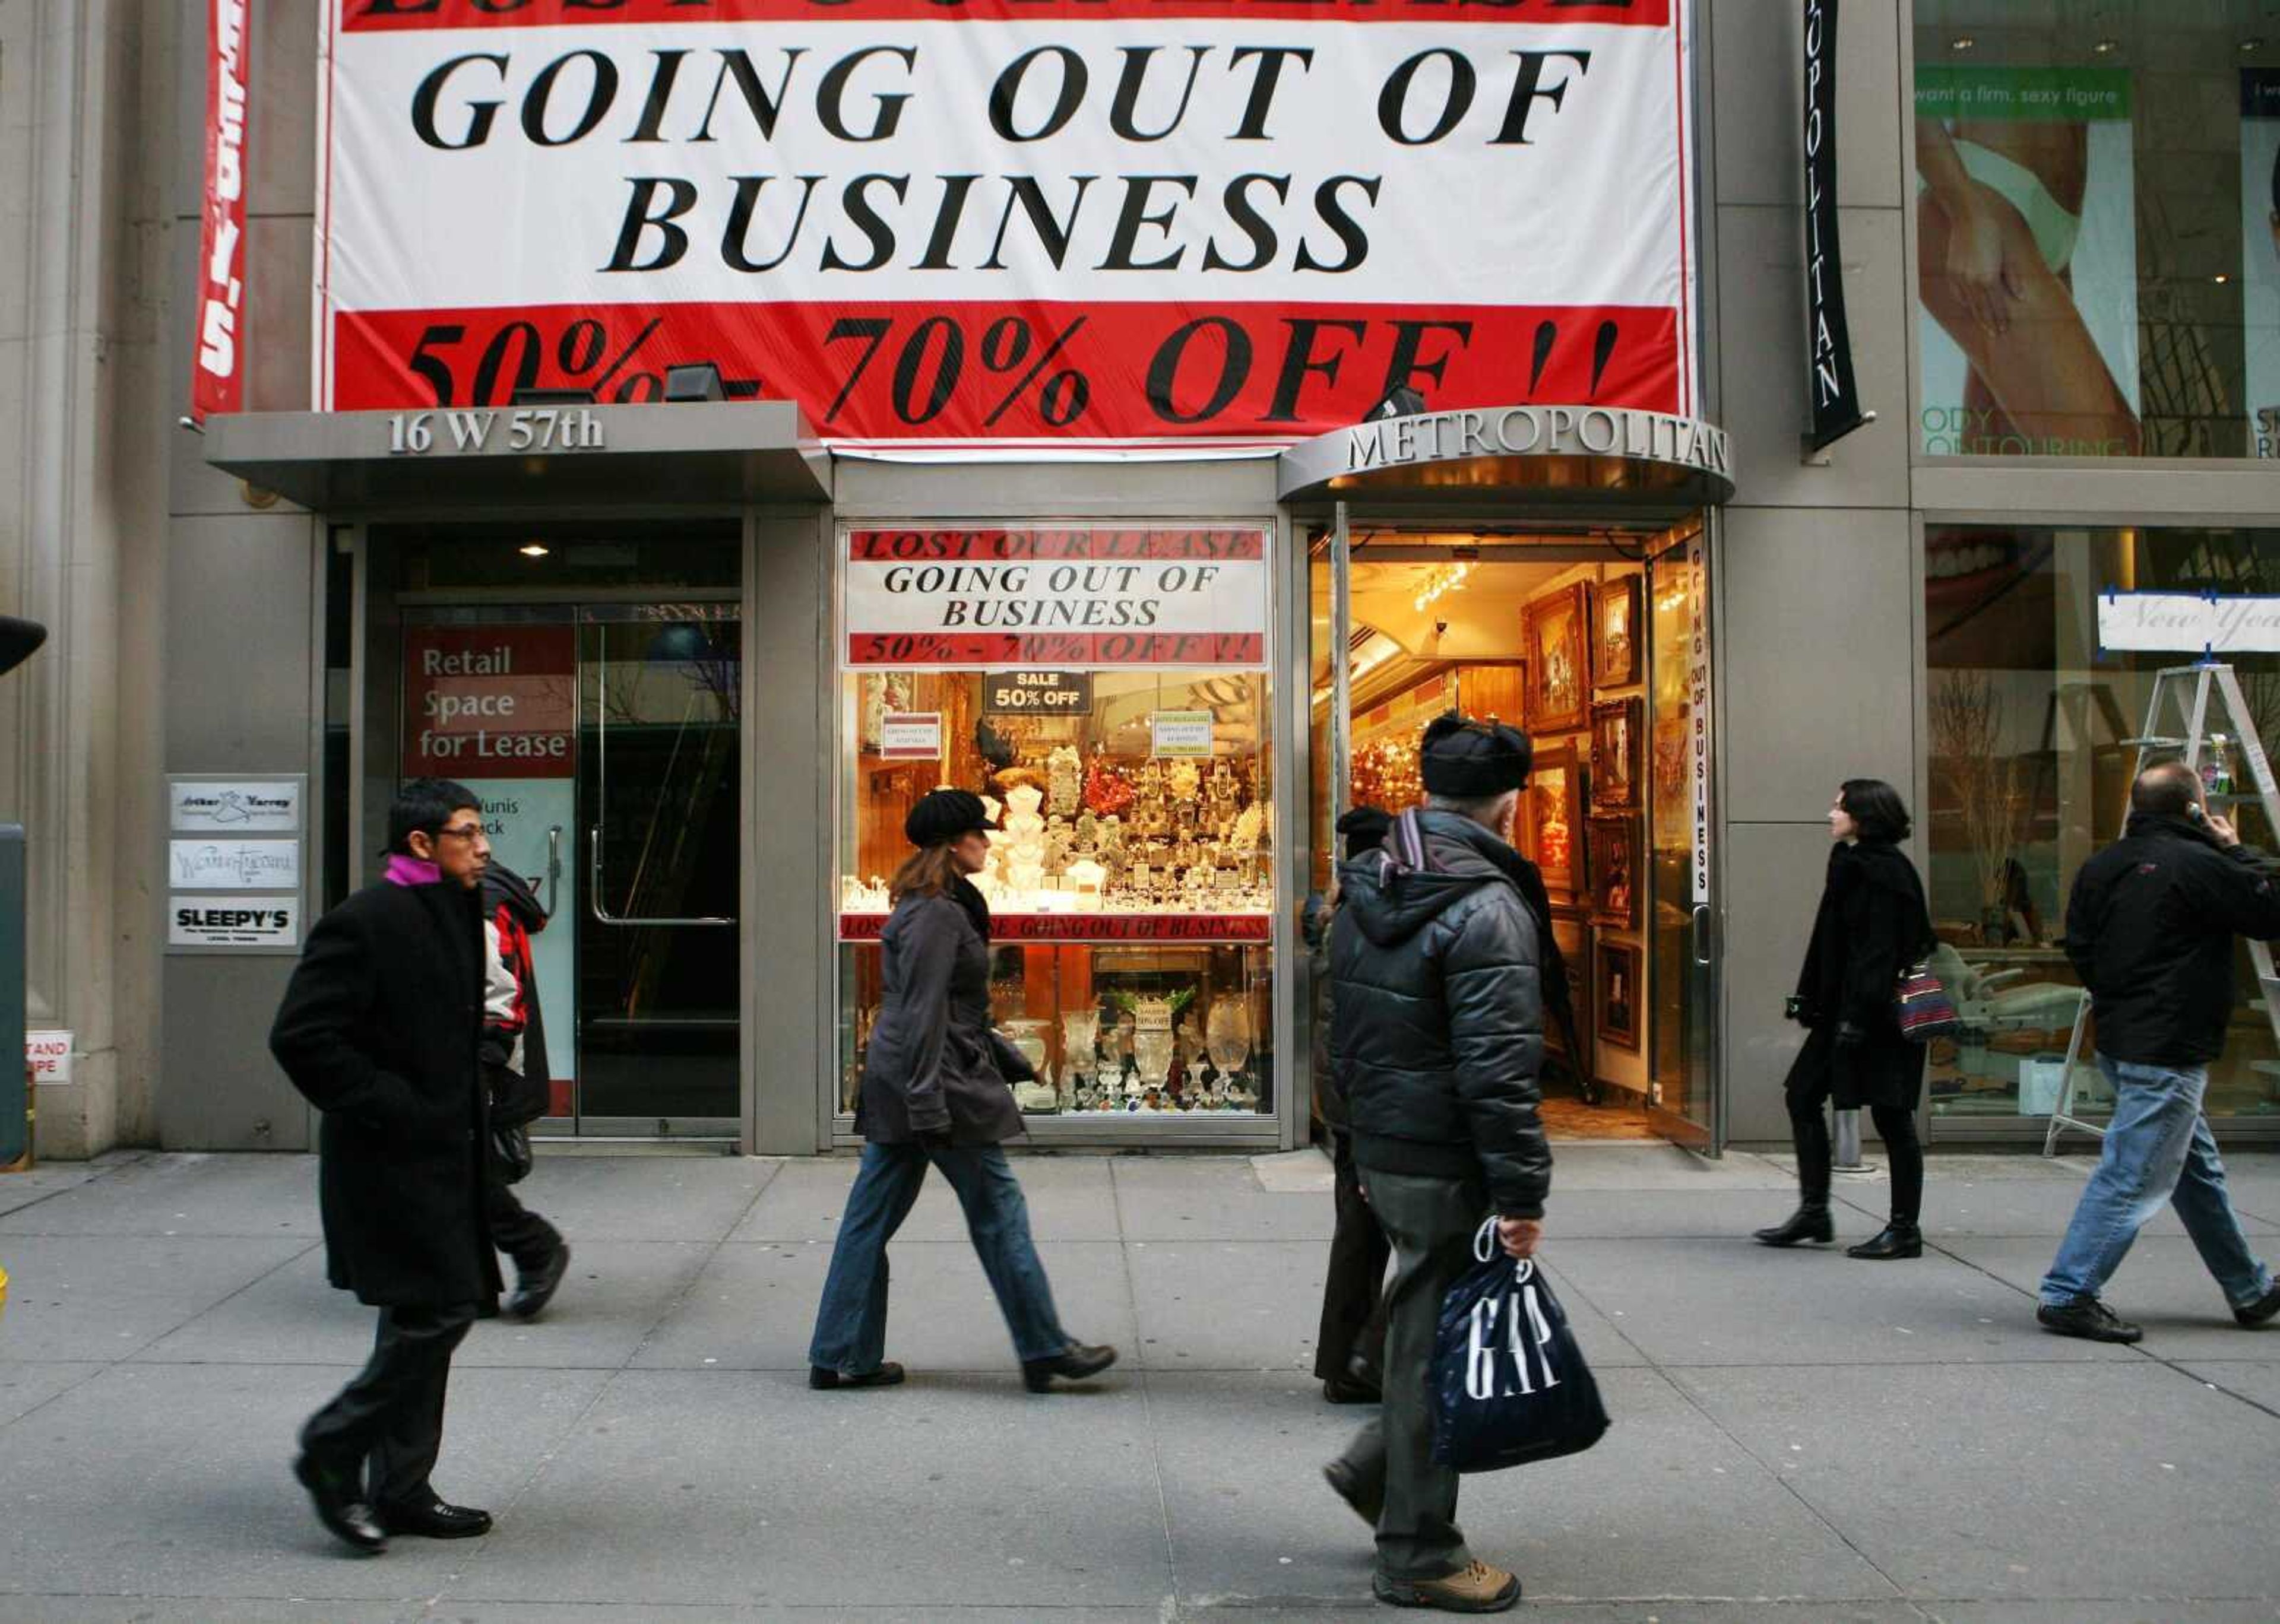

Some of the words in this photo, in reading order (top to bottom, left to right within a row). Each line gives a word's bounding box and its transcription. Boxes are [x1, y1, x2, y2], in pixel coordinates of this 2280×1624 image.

[411, 47, 919, 150] GOING
[988, 44, 1315, 142] OUT
[1375, 47, 1592, 145] OF
[1913, 88, 1955, 102] want
[1961, 90, 1973, 102] a
[2021, 88, 2061, 107] sexy
[2066, 85, 2118, 106] figure
[594, 172, 1383, 274] BUSINESS
[407, 318, 665, 410] 50%
[822, 315, 1091, 430] 70%
[1144, 315, 1474, 424] OFF
[387, 413, 433, 454] 16
[446, 410, 501, 452] W
[508, 408, 605, 451] 57th
[1345, 407, 1728, 473] METROPOLITAN
[862, 529, 983, 559] LOST
[992, 529, 1090, 559] OUR
[1101, 529, 1257, 559] LEASE
[884, 566, 1030, 594] GOING
[1048, 566, 1141, 594] OUT
[1157, 566, 1220, 594] OF
[941, 598, 1161, 627] BUSINESS
[422, 646, 511, 675] Retail
[865, 635, 954, 662] 50%
[1002, 635, 1085, 662] 70%
[1101, 635, 1200, 662] OFF
[1016, 673, 1059, 686] SALE
[1692, 665, 1706, 683] OUT
[424, 689, 515, 726] Space
[995, 689, 1040, 707] 50%
[1043, 691, 1080, 706] OFF
[1694, 689, 1705, 705] OF
[419, 729, 467, 757] for
[477, 729, 566, 758] Lease
[481, 798, 518, 814] unis
[1696, 718, 1706, 890] BUSINESS
[177, 909, 290, 928] SLEEPY'S
[1020, 917, 1085, 937] GOING
[1089, 917, 1129, 937] OUT
[1136, 917, 1164, 937] OF
[1169, 917, 1265, 937] BUSINESS
